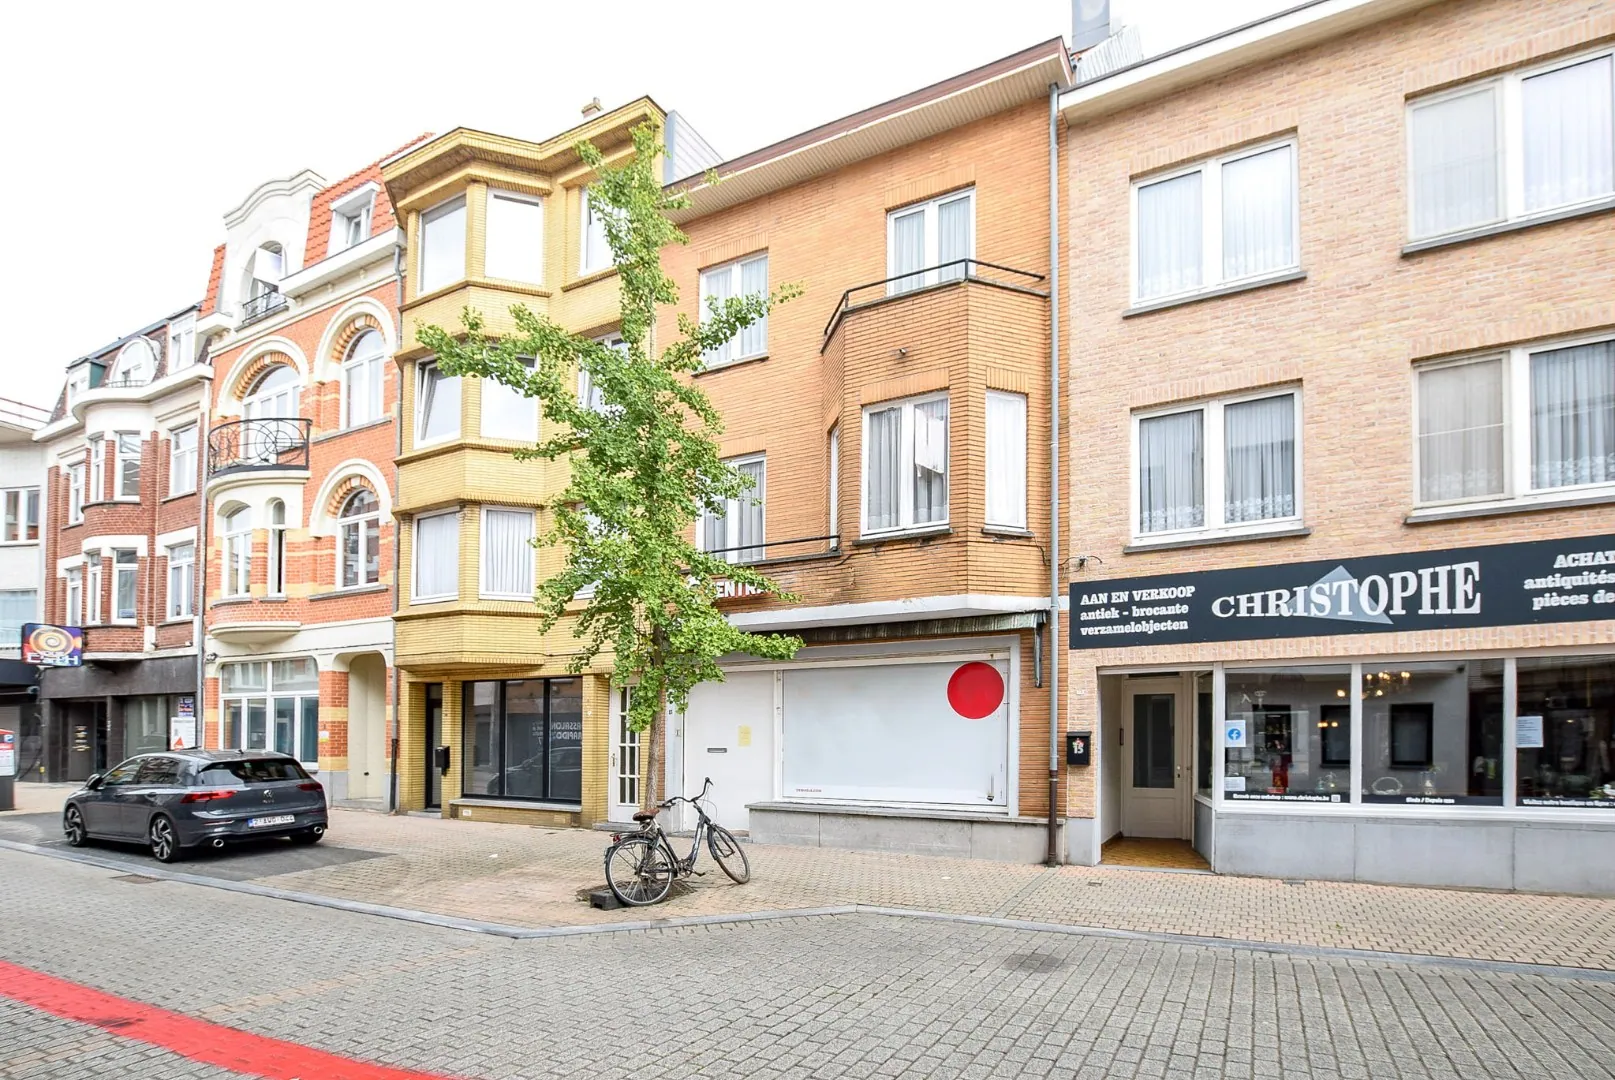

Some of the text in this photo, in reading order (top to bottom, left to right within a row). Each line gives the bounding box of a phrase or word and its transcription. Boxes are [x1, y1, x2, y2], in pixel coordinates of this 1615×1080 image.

[1553, 550, 1615, 568] ACHAT
[1523, 569, 1615, 590] antiquités
[1080, 586, 1196, 605] AAN EN VERKOOP
[1211, 561, 1481, 617] CHRISTOPHE
[1532, 592, 1589, 611] pièces
[1080, 606, 1120, 621] antiek
[1132, 603, 1189, 618] brocante
[1080, 620, 1188, 636] verzamelobjecten
[1072, 746, 1084, 754] 15
